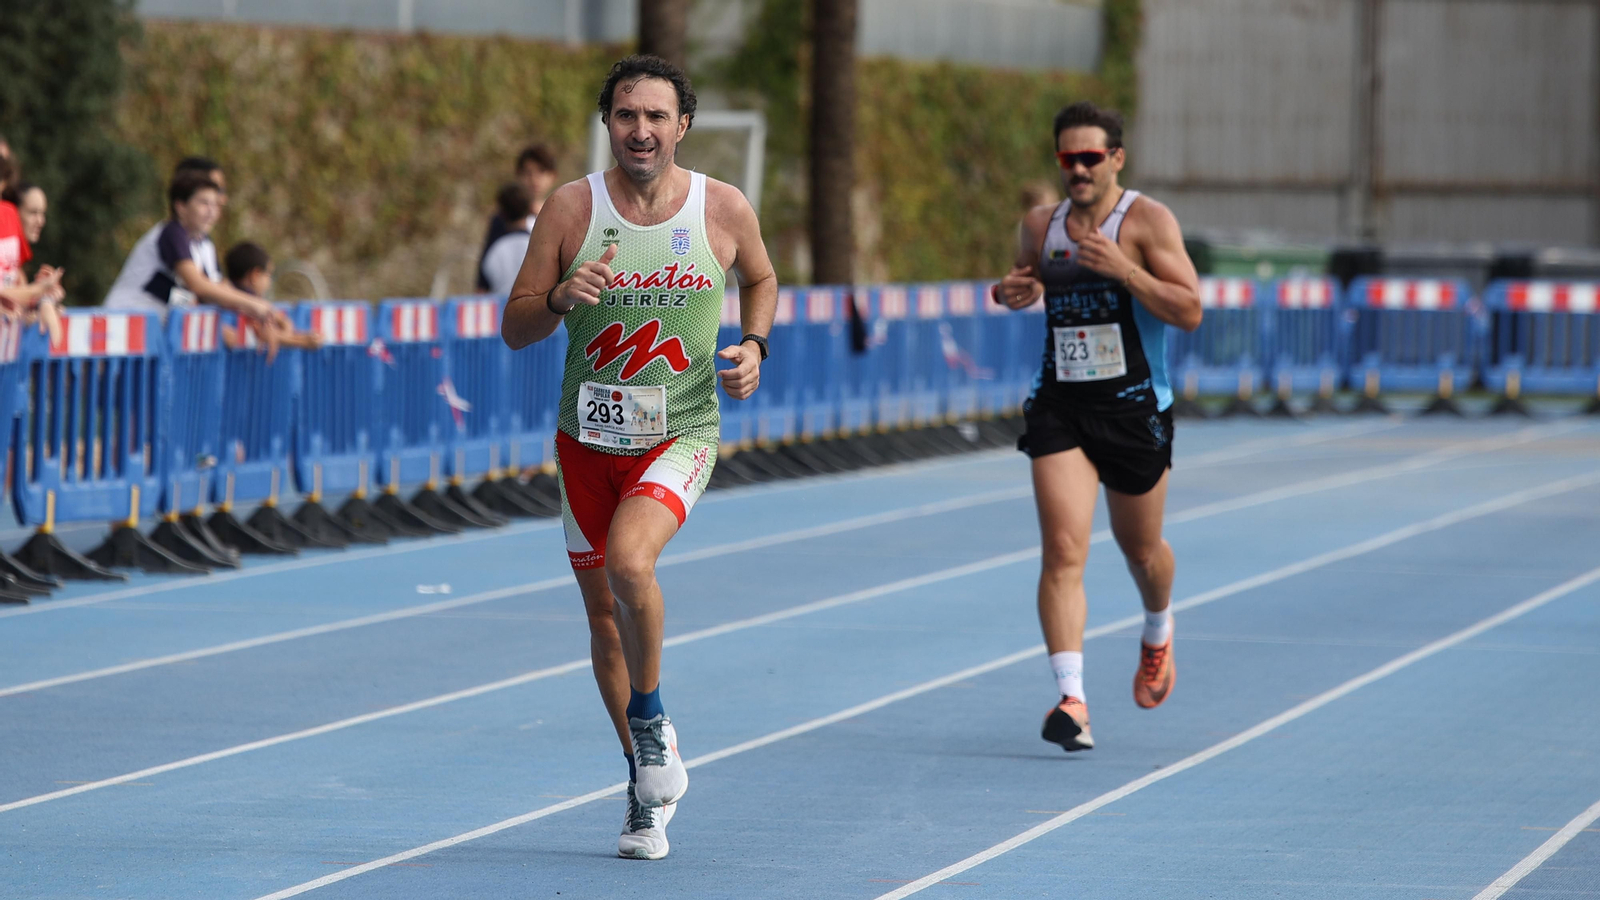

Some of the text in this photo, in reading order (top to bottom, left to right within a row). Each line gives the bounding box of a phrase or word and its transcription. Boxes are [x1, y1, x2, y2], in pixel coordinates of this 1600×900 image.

[607, 261, 713, 291] aratón
[605, 293, 688, 307] JEREZ
[586, 400, 625, 426] 293
